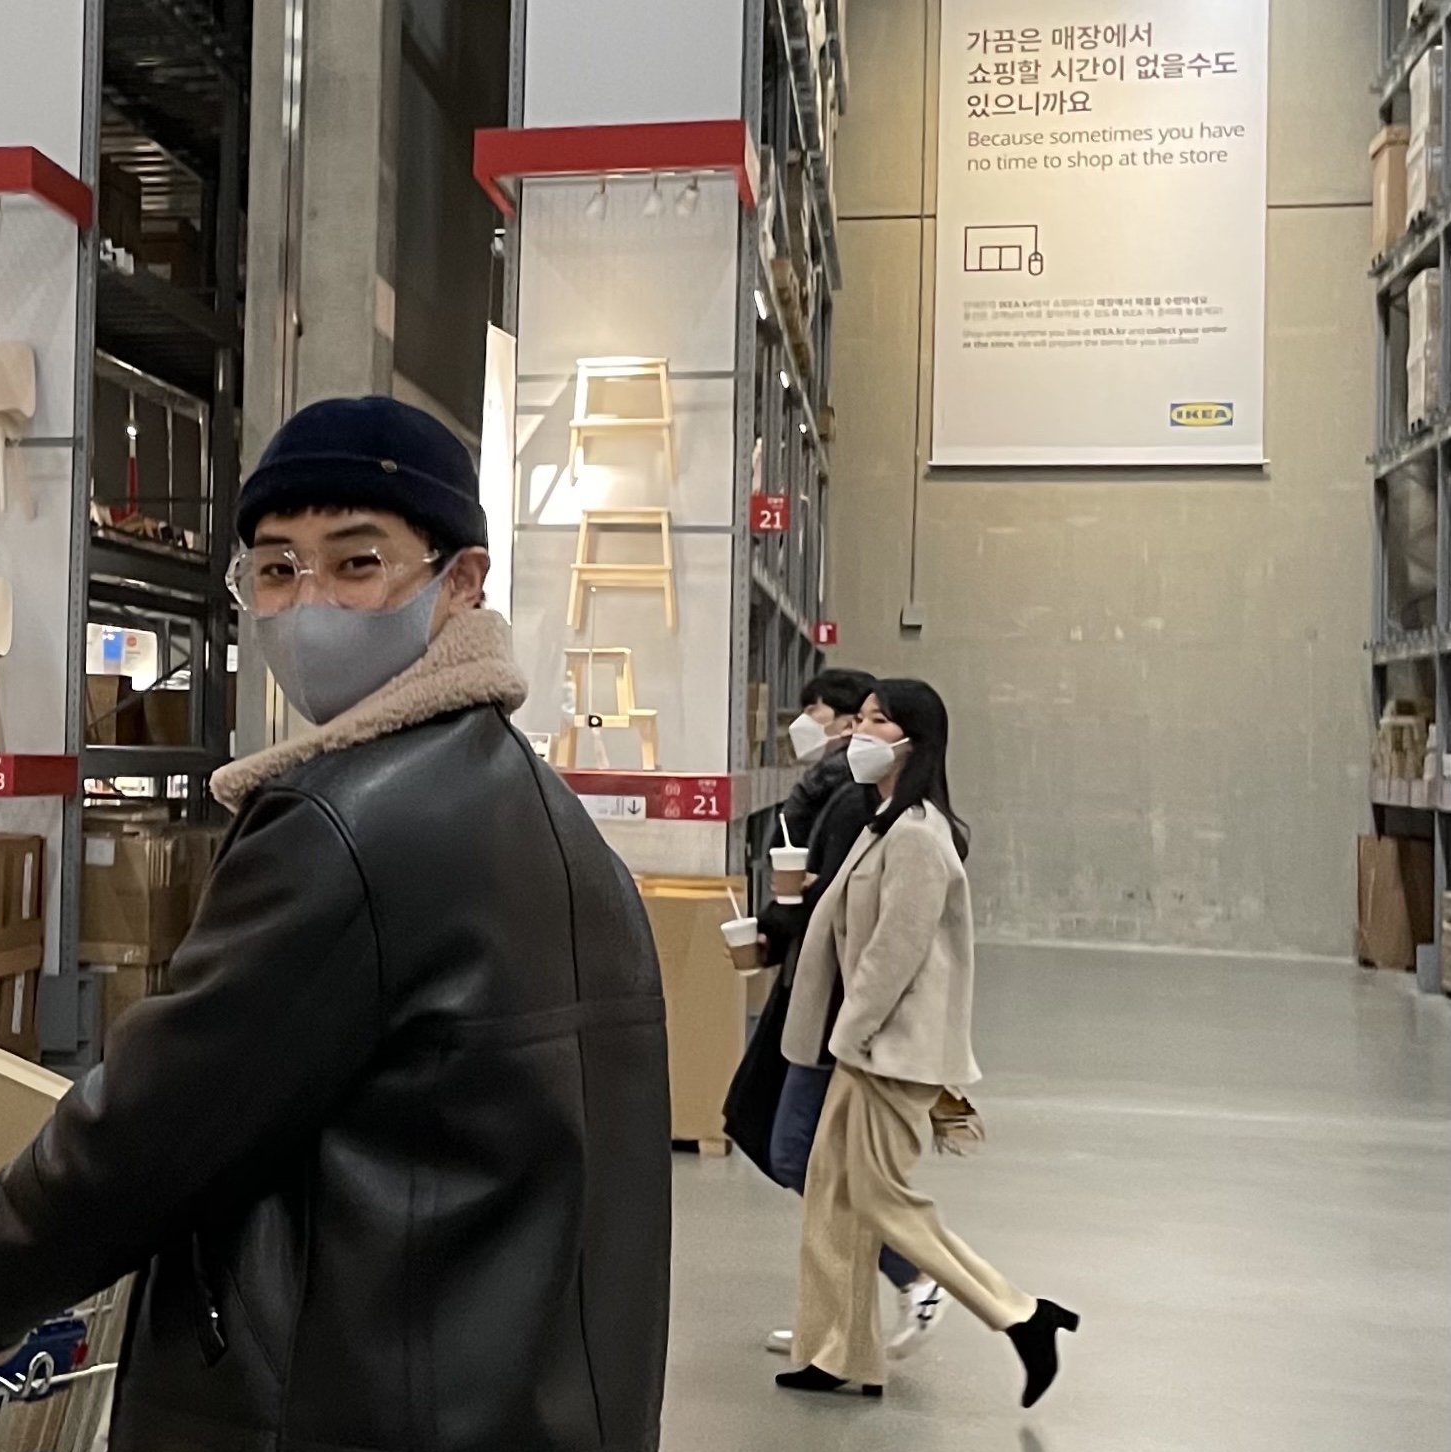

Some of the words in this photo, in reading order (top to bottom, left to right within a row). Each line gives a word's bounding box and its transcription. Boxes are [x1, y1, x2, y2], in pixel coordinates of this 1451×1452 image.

[967, 29, 1042, 54] 가끔은
[1051, 22, 1153, 50] 매장에서
[967, 59, 1041, 85] 쇼핑할
[1051, 55, 1124, 83] 시간이
[1136, 51, 1238, 80] 없을수도
[967, 90, 1092, 118] 있으니까요
[968, 131, 1044, 147] Because
[1050, 126, 1153, 144] sometimes
[1158, 124, 1193, 145] you
[1200, 122, 1245, 138] have
[967, 158, 991, 171] no
[997, 154, 1038, 170] time
[1044, 154, 1062, 169] to
[1067, 151, 1113, 171] shop
[1119, 151, 1137, 166] at
[1143, 148, 1173, 165] the
[1179, 148, 1228, 164] store
[1174, 407, 1229, 421] IKEA
[759, 509, 784, 529] 21
[693, 794, 719, 816] 21
